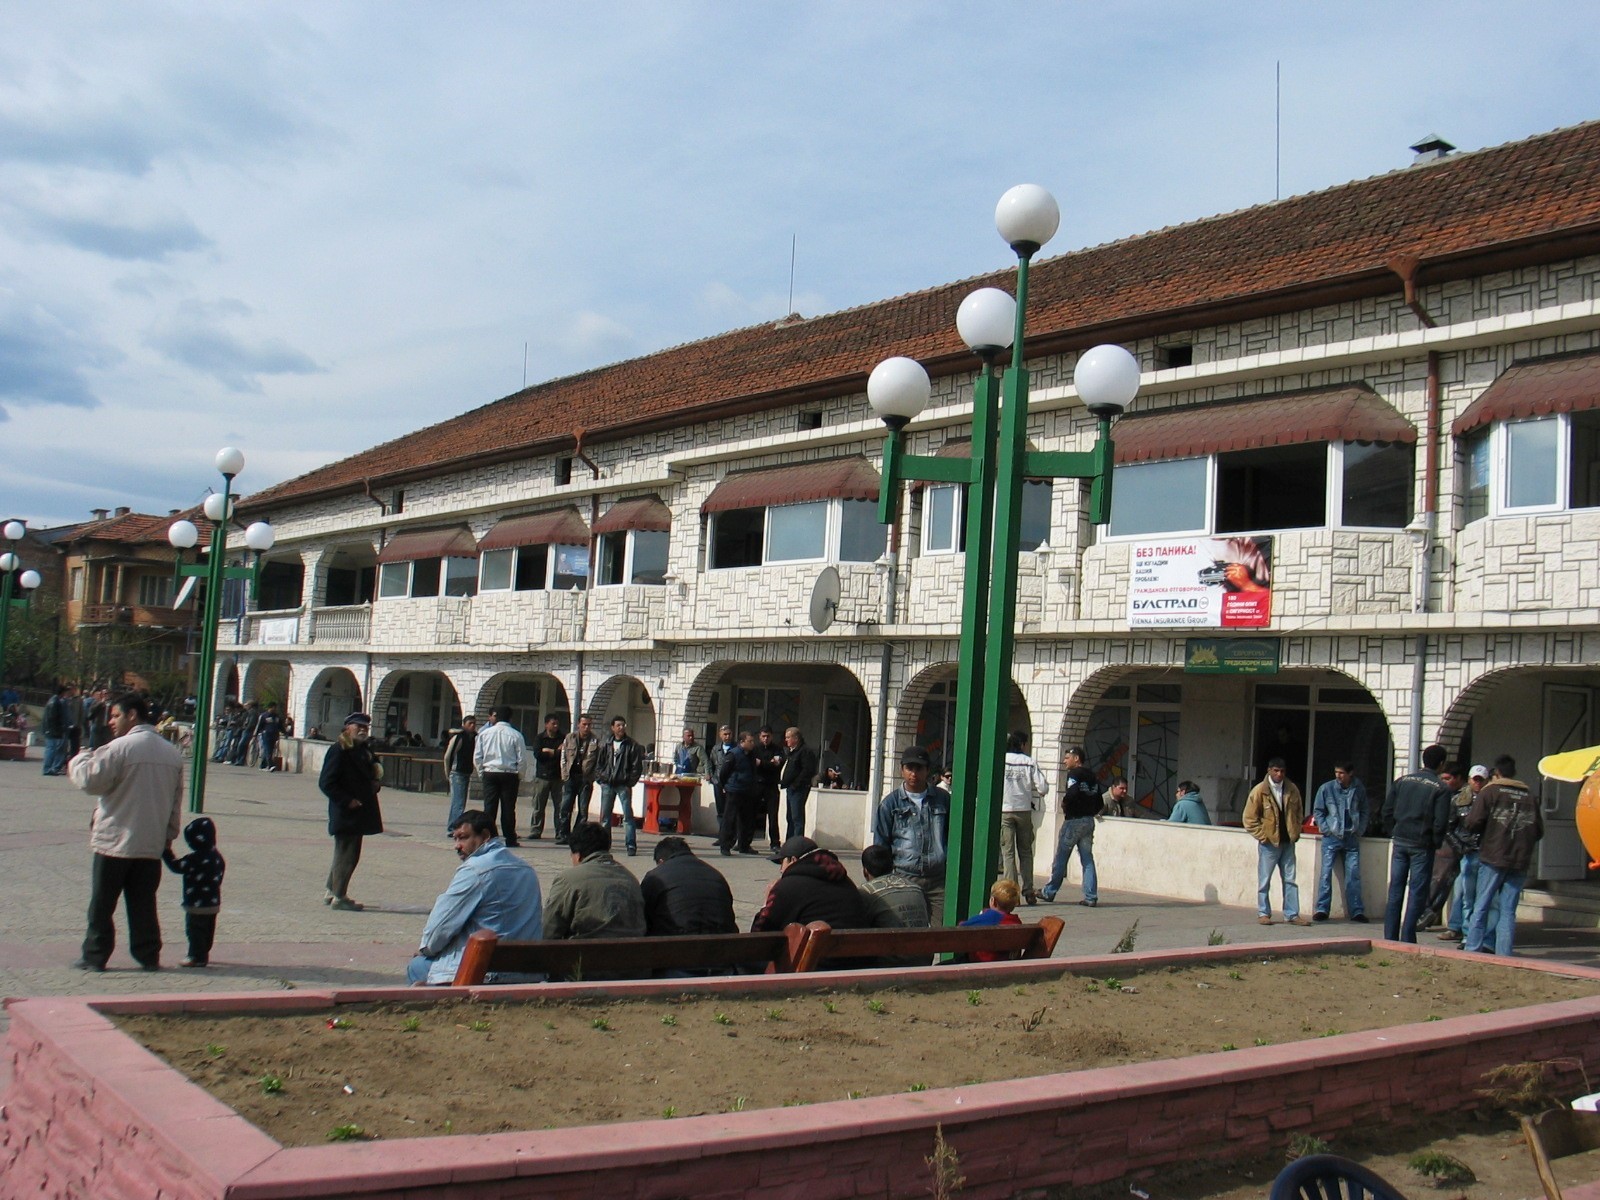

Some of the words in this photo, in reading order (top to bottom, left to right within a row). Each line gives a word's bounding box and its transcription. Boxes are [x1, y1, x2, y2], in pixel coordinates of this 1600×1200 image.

[1136, 548, 1153, 558] БЕЗ
[1155, 545, 1197, 557] ПАНИКА!
[1133, 598, 1198, 609] БУЛСТРАД
